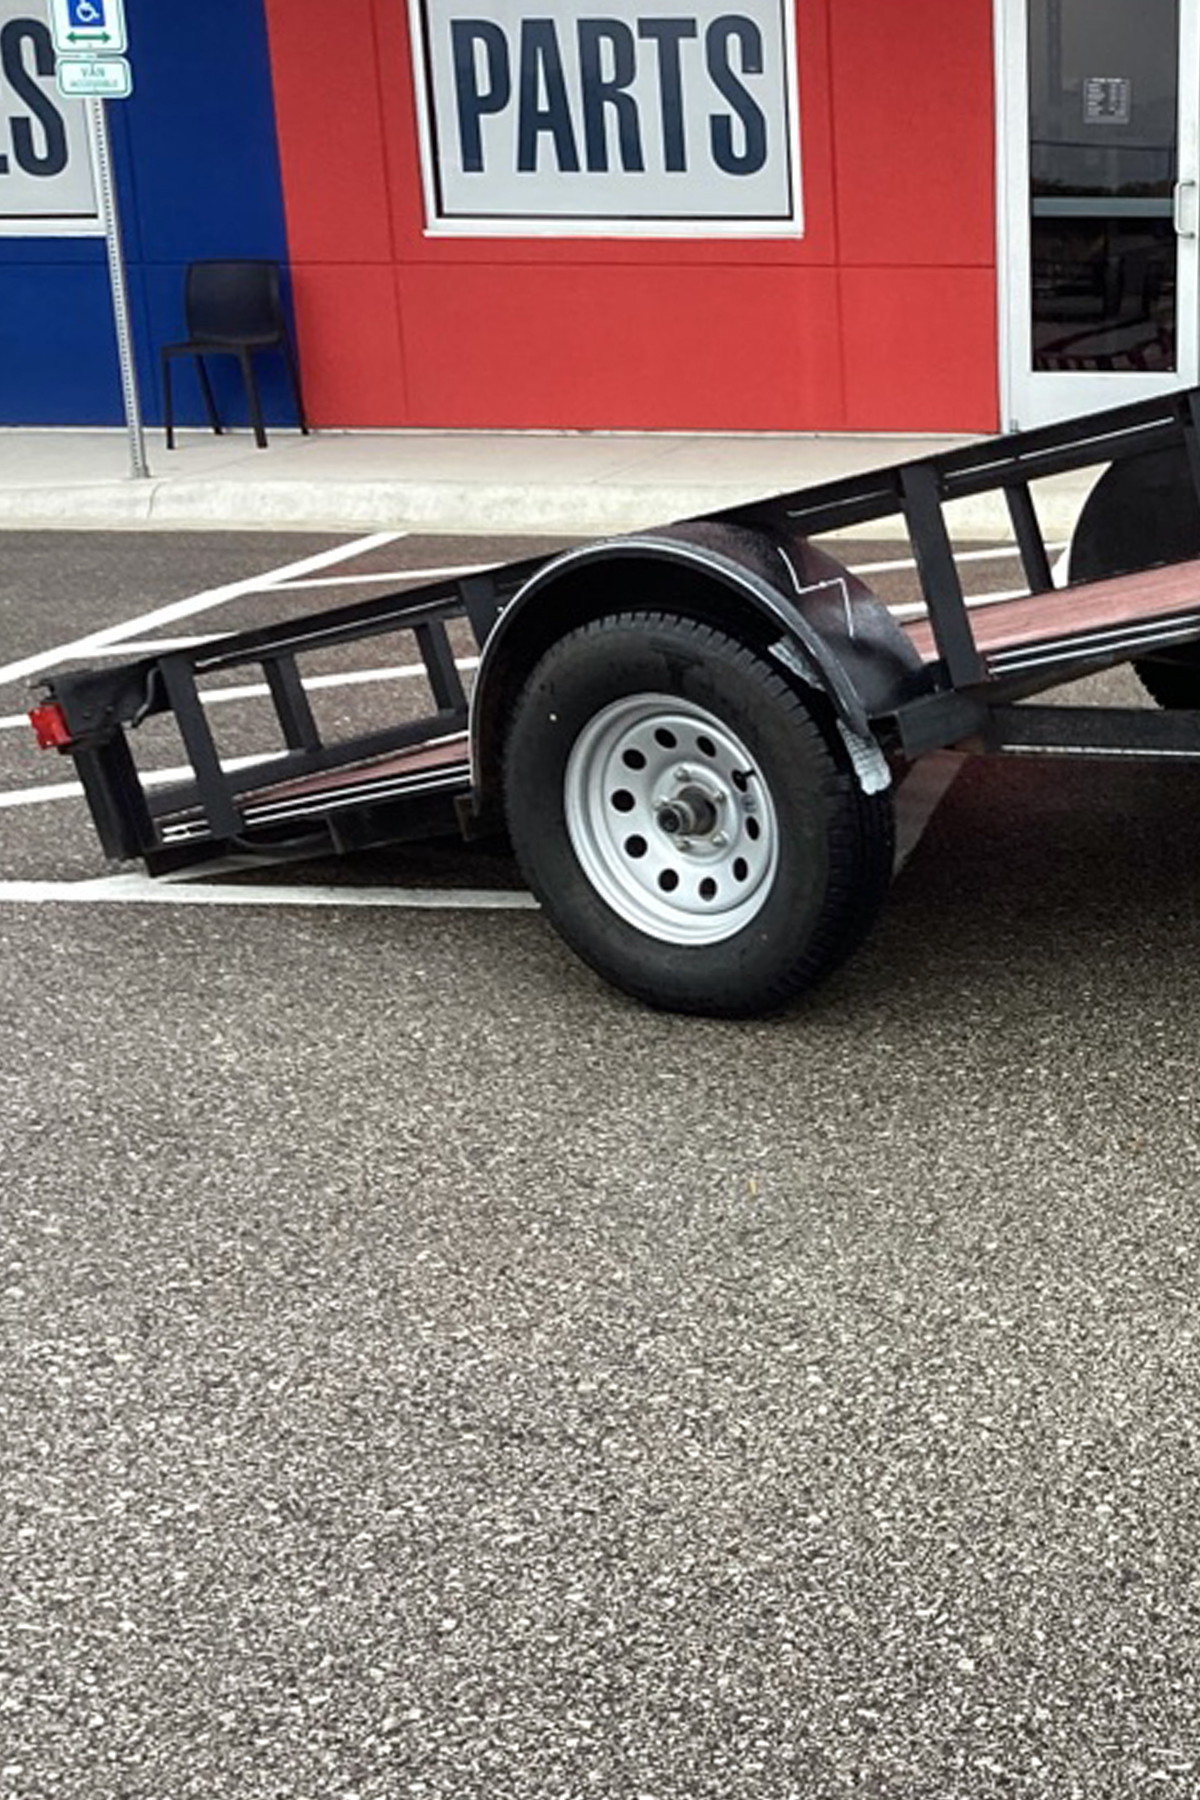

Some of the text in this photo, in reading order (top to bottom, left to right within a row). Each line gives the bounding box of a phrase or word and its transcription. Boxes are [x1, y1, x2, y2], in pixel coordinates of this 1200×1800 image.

[0, 18, 69, 177] S
[80, 67, 106, 77] VAN
[450, 14, 768, 176] PARTS
